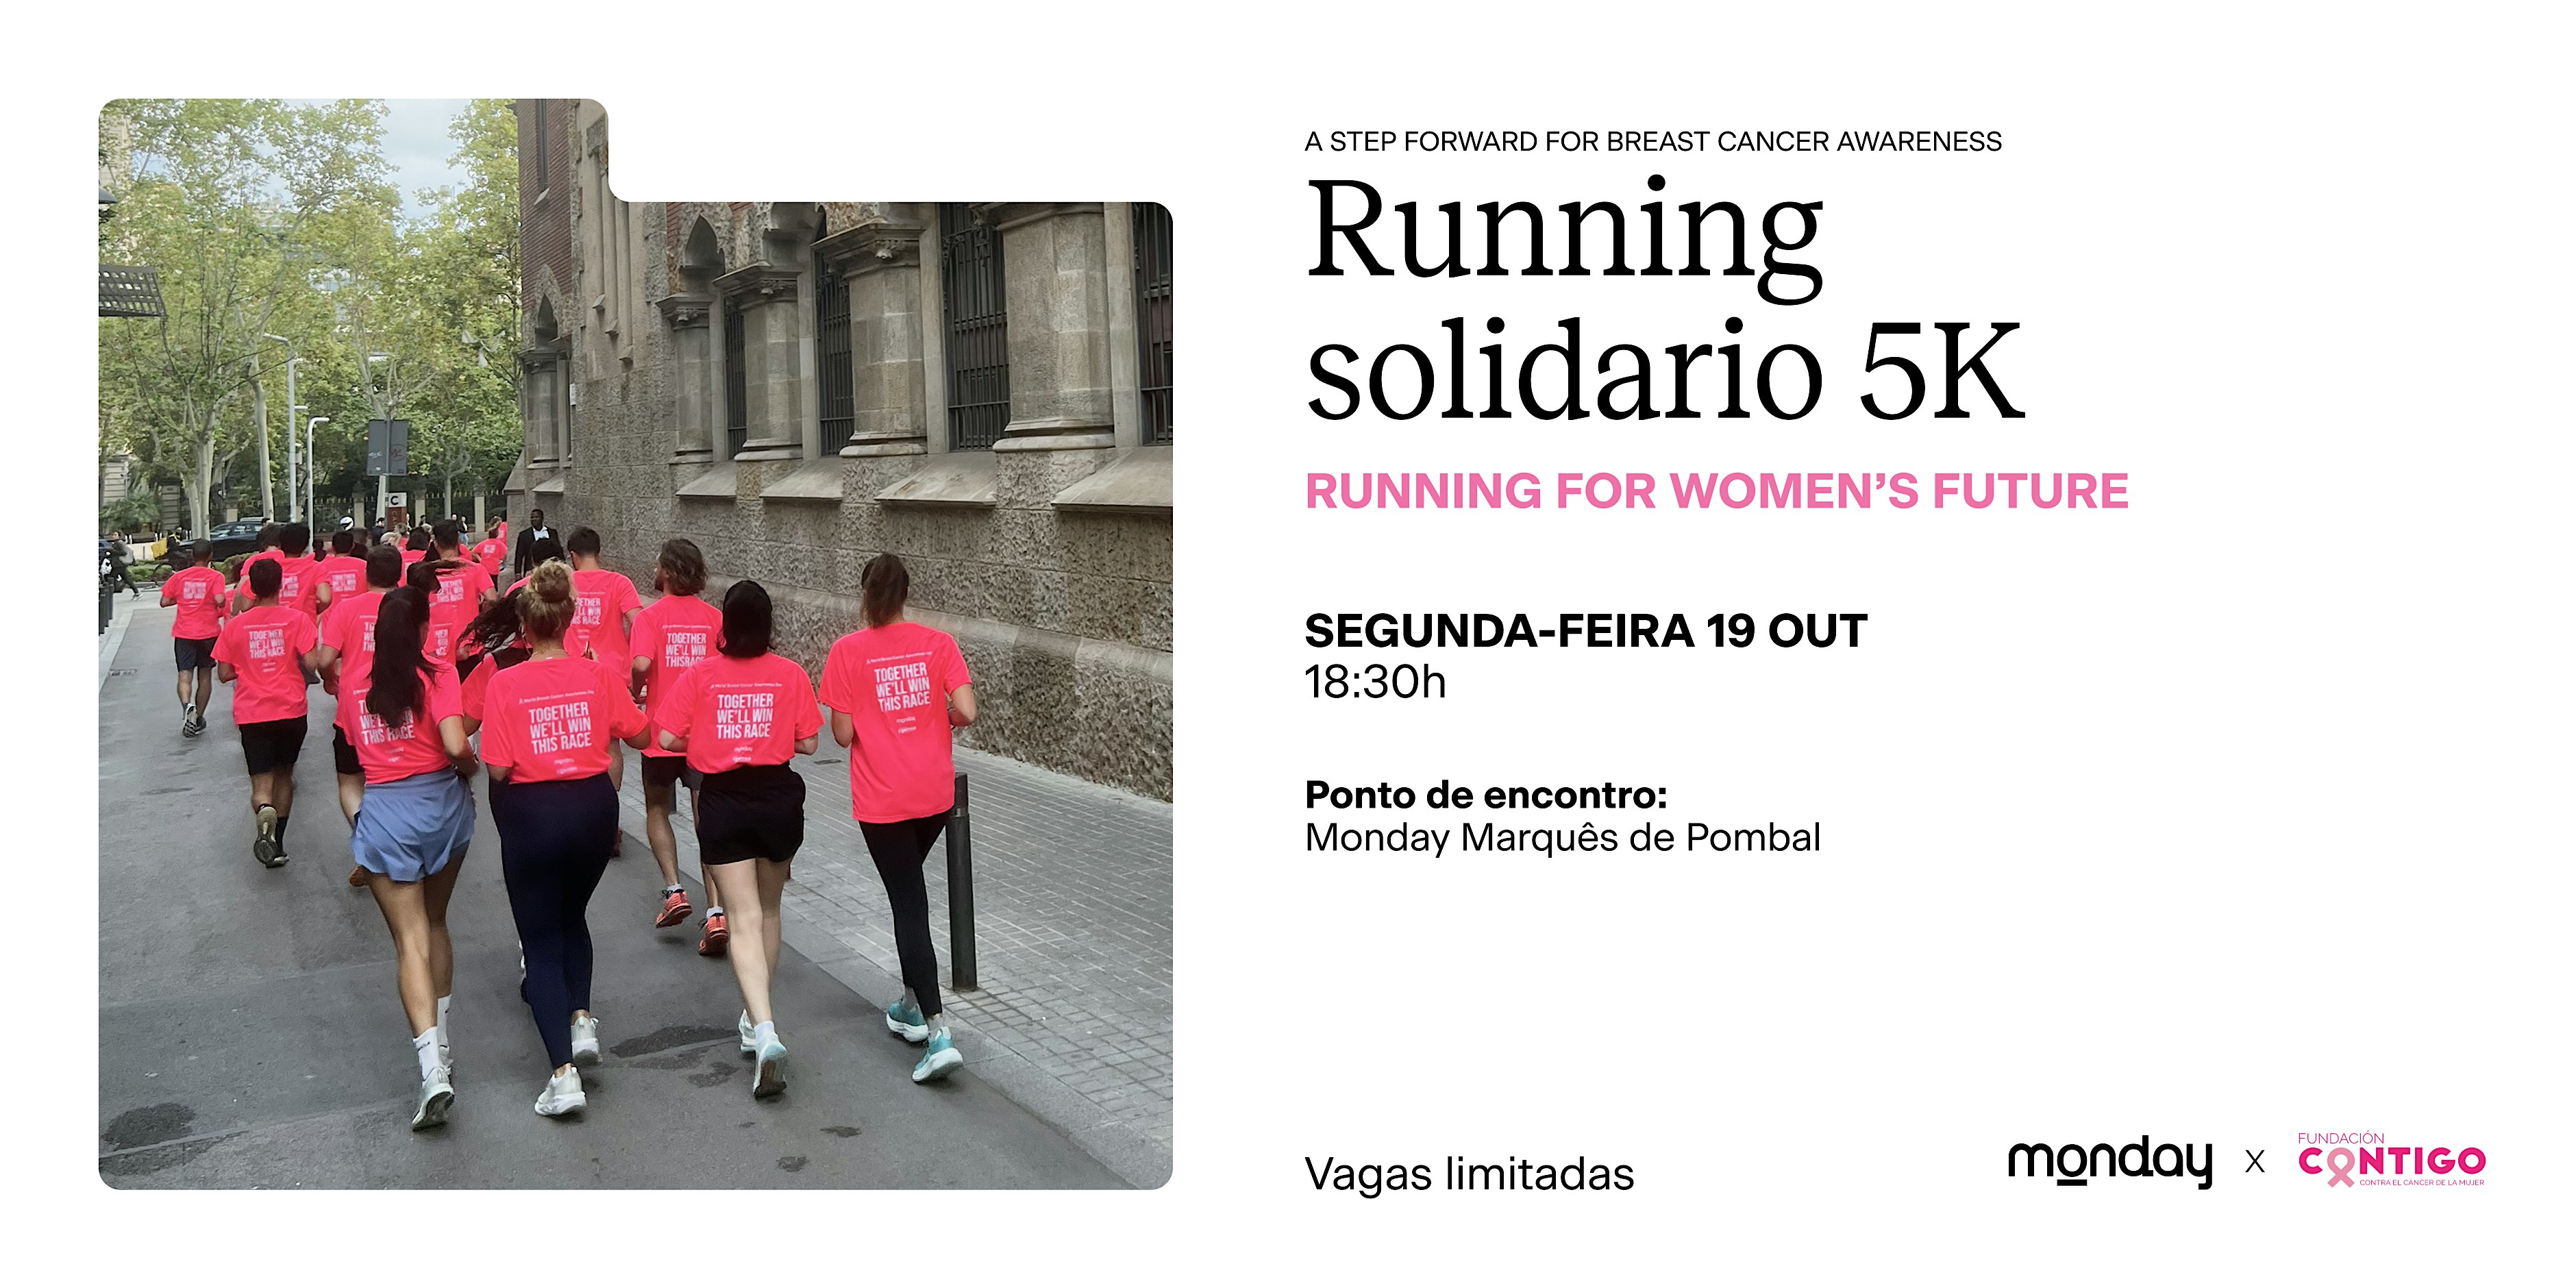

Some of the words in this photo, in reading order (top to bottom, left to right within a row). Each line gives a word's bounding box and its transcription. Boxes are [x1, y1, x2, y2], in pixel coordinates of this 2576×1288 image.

[249, 628, 283, 641] TOGETHER
[667, 632, 706, 645] TOGETHER
[691, 644, 706, 656] WIN
[874, 662, 928, 683] TOGETHER
[876, 680, 907, 698] WE'LL
[908, 676, 930, 693] WIN
[717, 693, 773, 709] TOGETHER
[878, 695, 902, 713] THIS
[902, 691, 932, 709] RACE
[528, 702, 589, 723] TOGETHER
[717, 708, 750, 724] WE'LL
[752, 708, 773, 723] WIN
[530, 720, 566, 739] WE'LL
[567, 716, 591, 734] WIN
[716, 724, 742, 739] THIS
[743, 723, 771, 738] RACE
[362, 728, 385, 745] THIS
[532, 736, 558, 754] THIS
[560, 732, 593, 750] RACE
